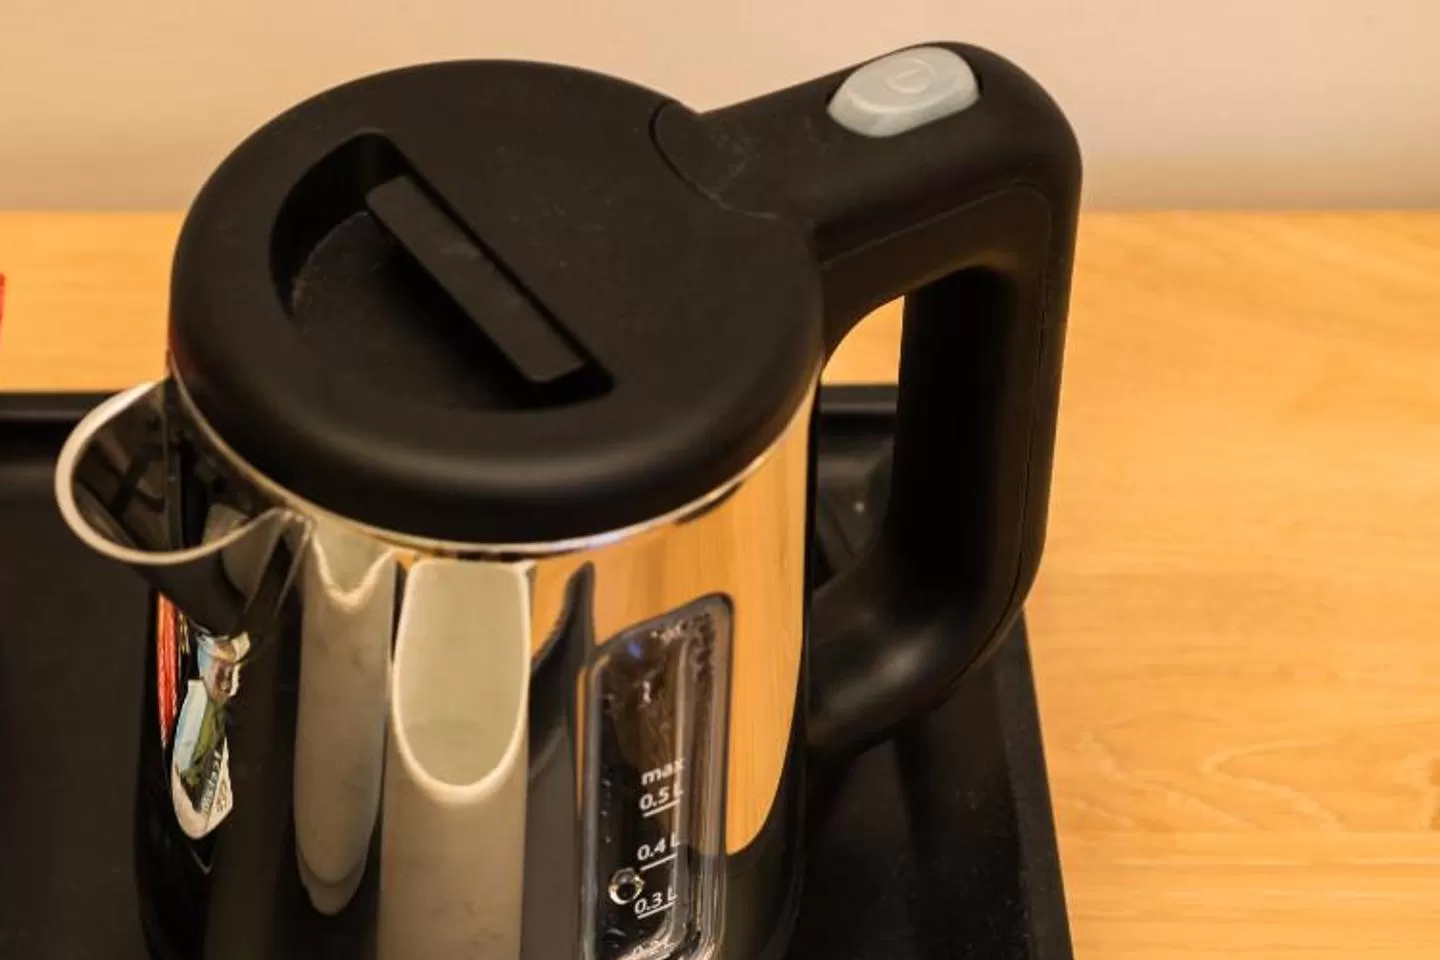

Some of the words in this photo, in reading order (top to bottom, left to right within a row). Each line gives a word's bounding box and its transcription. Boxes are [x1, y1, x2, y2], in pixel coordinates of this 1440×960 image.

[639, 785, 670, 812] 0.5
[636, 836, 666, 862] 0.4
[634, 891, 664, 915] 0.3
